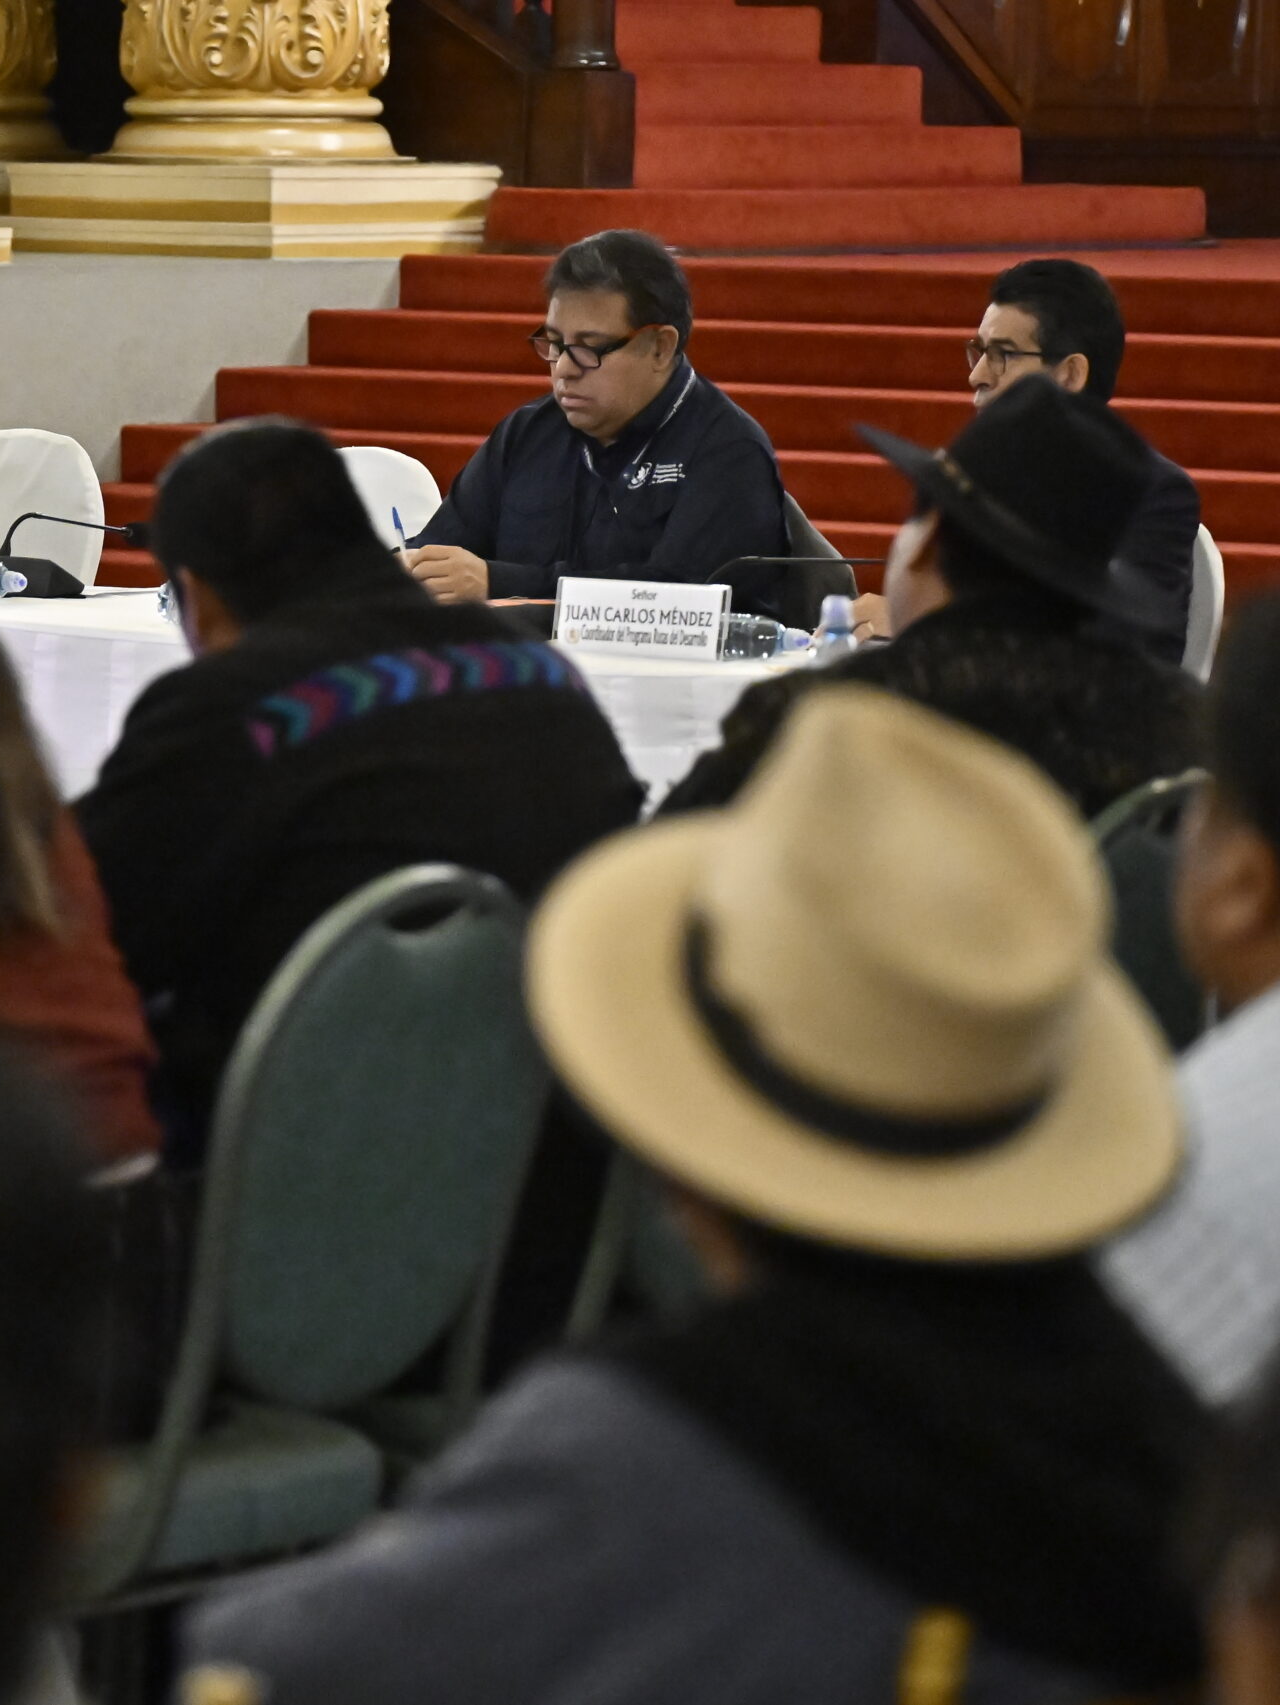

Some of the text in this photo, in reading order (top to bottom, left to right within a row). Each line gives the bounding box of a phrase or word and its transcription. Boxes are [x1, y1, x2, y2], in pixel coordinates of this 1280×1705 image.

[632, 589, 657, 600] Señor
[565, 604, 713, 628] JUAN CARLOS MÉNDEZ
[581, 624, 615, 642] Coordinador
[626, 626, 651, 646] Programa
[679, 630, 708, 647] Desarrollo
